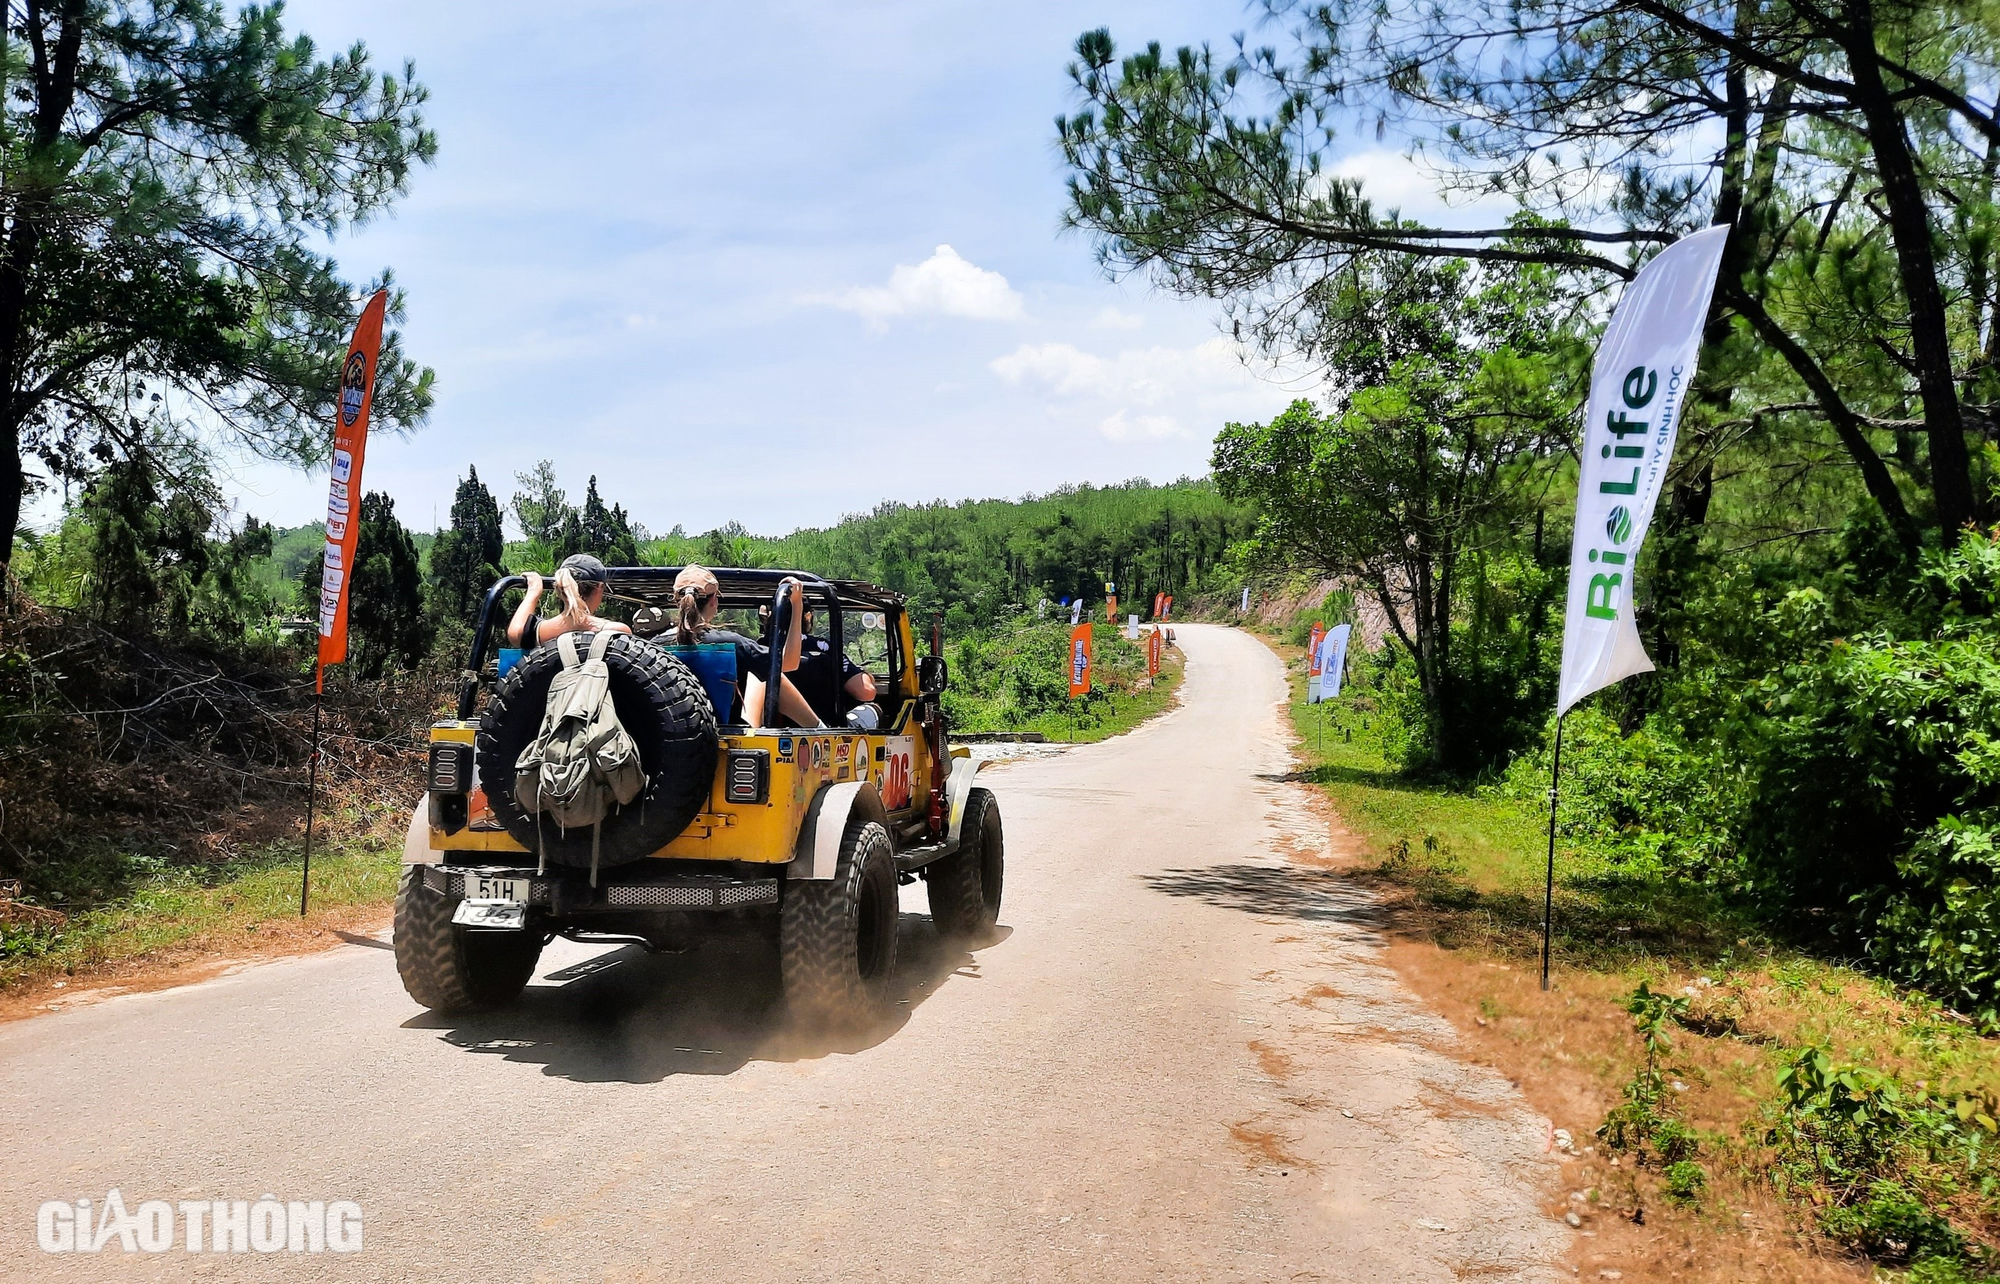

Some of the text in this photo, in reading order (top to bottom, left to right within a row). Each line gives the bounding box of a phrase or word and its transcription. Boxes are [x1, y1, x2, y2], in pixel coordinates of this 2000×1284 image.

[1656, 406, 1674, 446] SINH
[888, 752, 909, 809] 06
[479, 879, 514, 901] 51H
